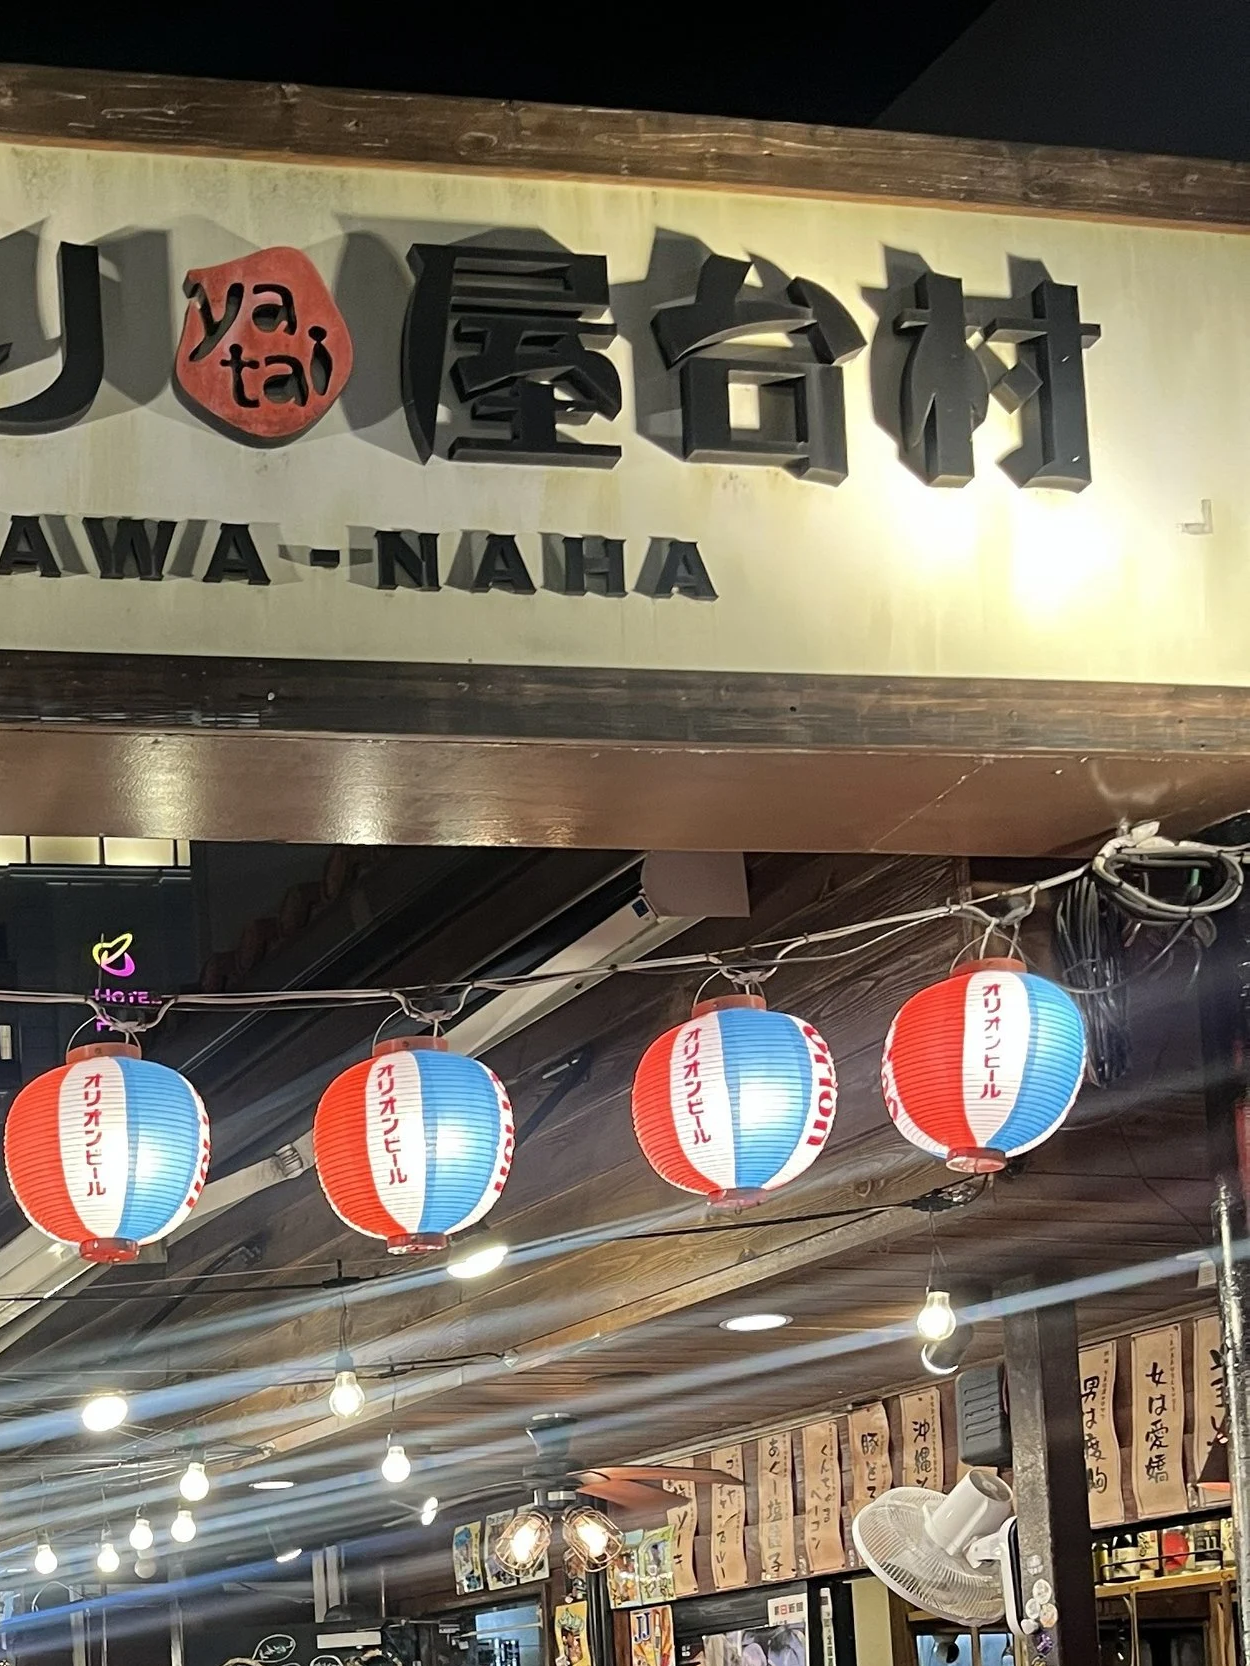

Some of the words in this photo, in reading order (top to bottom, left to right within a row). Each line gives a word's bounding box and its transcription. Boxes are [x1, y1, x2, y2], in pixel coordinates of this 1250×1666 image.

[188, 282, 297, 362] ya
[219, 325, 334, 408] tai
[401, 241, 1100, 492] 屋台村
[84, 1073, 106, 1196] オリオンビール
[377, 1063, 408, 1185] オリオンビール
[683, 1027, 711, 1145] オリオンビール
